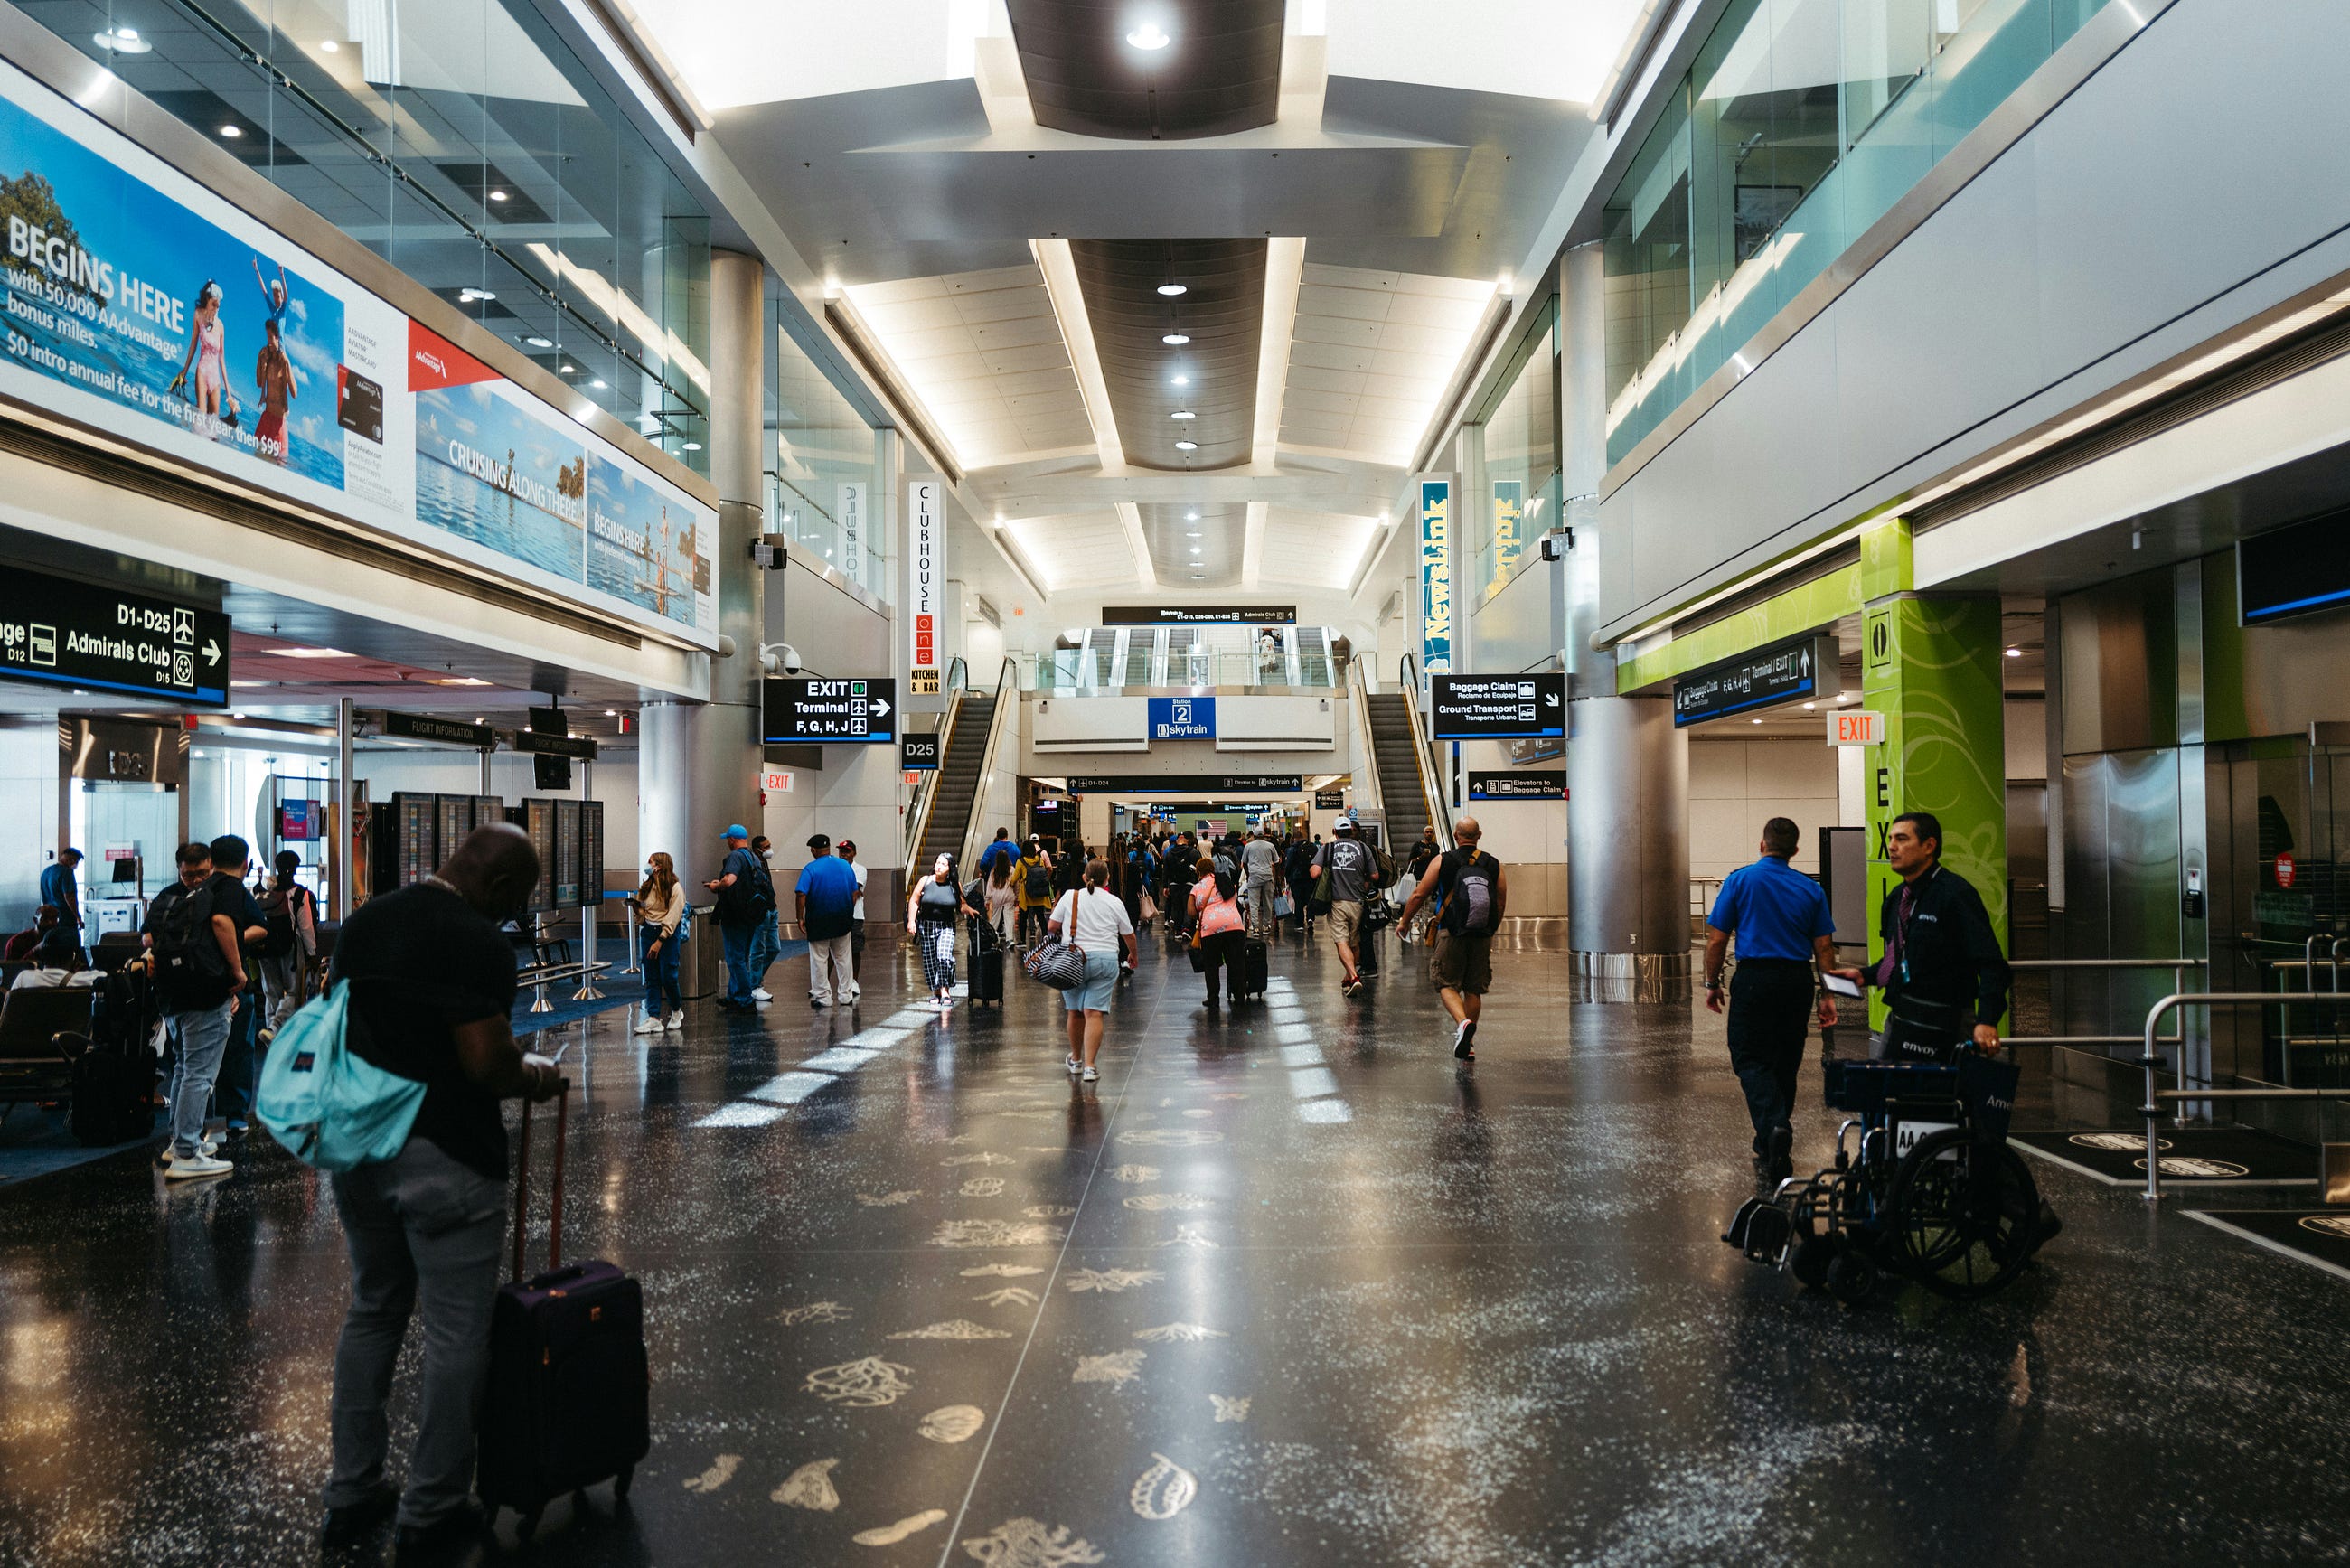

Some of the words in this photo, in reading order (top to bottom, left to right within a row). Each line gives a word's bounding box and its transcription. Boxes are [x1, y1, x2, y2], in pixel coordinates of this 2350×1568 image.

[10, 214, 115, 300] BEGINS
[121, 271, 184, 335] HERE
[8, 268, 43, 297] with
[46, 281, 96, 321] 50,000
[8, 290, 54, 330] bonus
[58, 317, 99, 349] miles.
[8, 329, 28, 356] $0
[31, 343, 67, 372] intro
[69, 361, 116, 390] annual
[118, 375, 139, 400] fee
[141, 385, 162, 408] for
[162, 392, 182, 418] the
[183, 403, 207, 428] first
[207, 415, 234, 442] year,
[234, 426, 259, 449] then
[448, 439, 507, 489] CRUISING
[508, 469, 546, 507] ALONG
[546, 488, 577, 521] THERE
[594, 512, 625, 544] BEGINS
[625, 527, 644, 555] HERE
[919, 486, 930, 613] CLUBHOUSE
[1424, 498, 1450, 641] NewsLink
[118, 603, 171, 634] D1-D25
[918, 618, 930, 662] one
[8, 647, 26, 662] D12
[66, 630, 134, 661] Admirals
[137, 643, 170, 667] Club
[1776, 654, 1788, 671] EXIT
[156, 671, 170, 684] D15
[911, 669, 939, 680] KITCHEN
[807, 681, 849, 697] EXIT
[911, 681, 917, 692] &
[923, 681, 939, 692] BAR
[1449, 682, 1489, 693] Baggage
[1490, 681, 1517, 691] Claim
[794, 701, 849, 713] Terminal
[1177, 706, 1188, 722] 2
[1439, 705, 1472, 714] Ground
[1474, 705, 1517, 715] Transport
[412, 721, 434, 734] FLIGHT
[435, 723, 474, 739] INFORMATION
[796, 720, 807, 734] F,
[809, 720, 823, 734] G,
[825, 720, 839, 734] H,
[841, 720, 849, 732] J
[1170, 724, 1208, 737] skytrain
[1838, 716, 1873, 741] EXIT
[906, 743, 935, 756] D25
[768, 774, 789, 790] EXIT
[905, 773, 919, 784] EXIT
[1266, 778, 1291, 786] skytrain
[1513, 786, 1541, 794] Baggage
[1903, 1040, 1937, 1056] envoy
